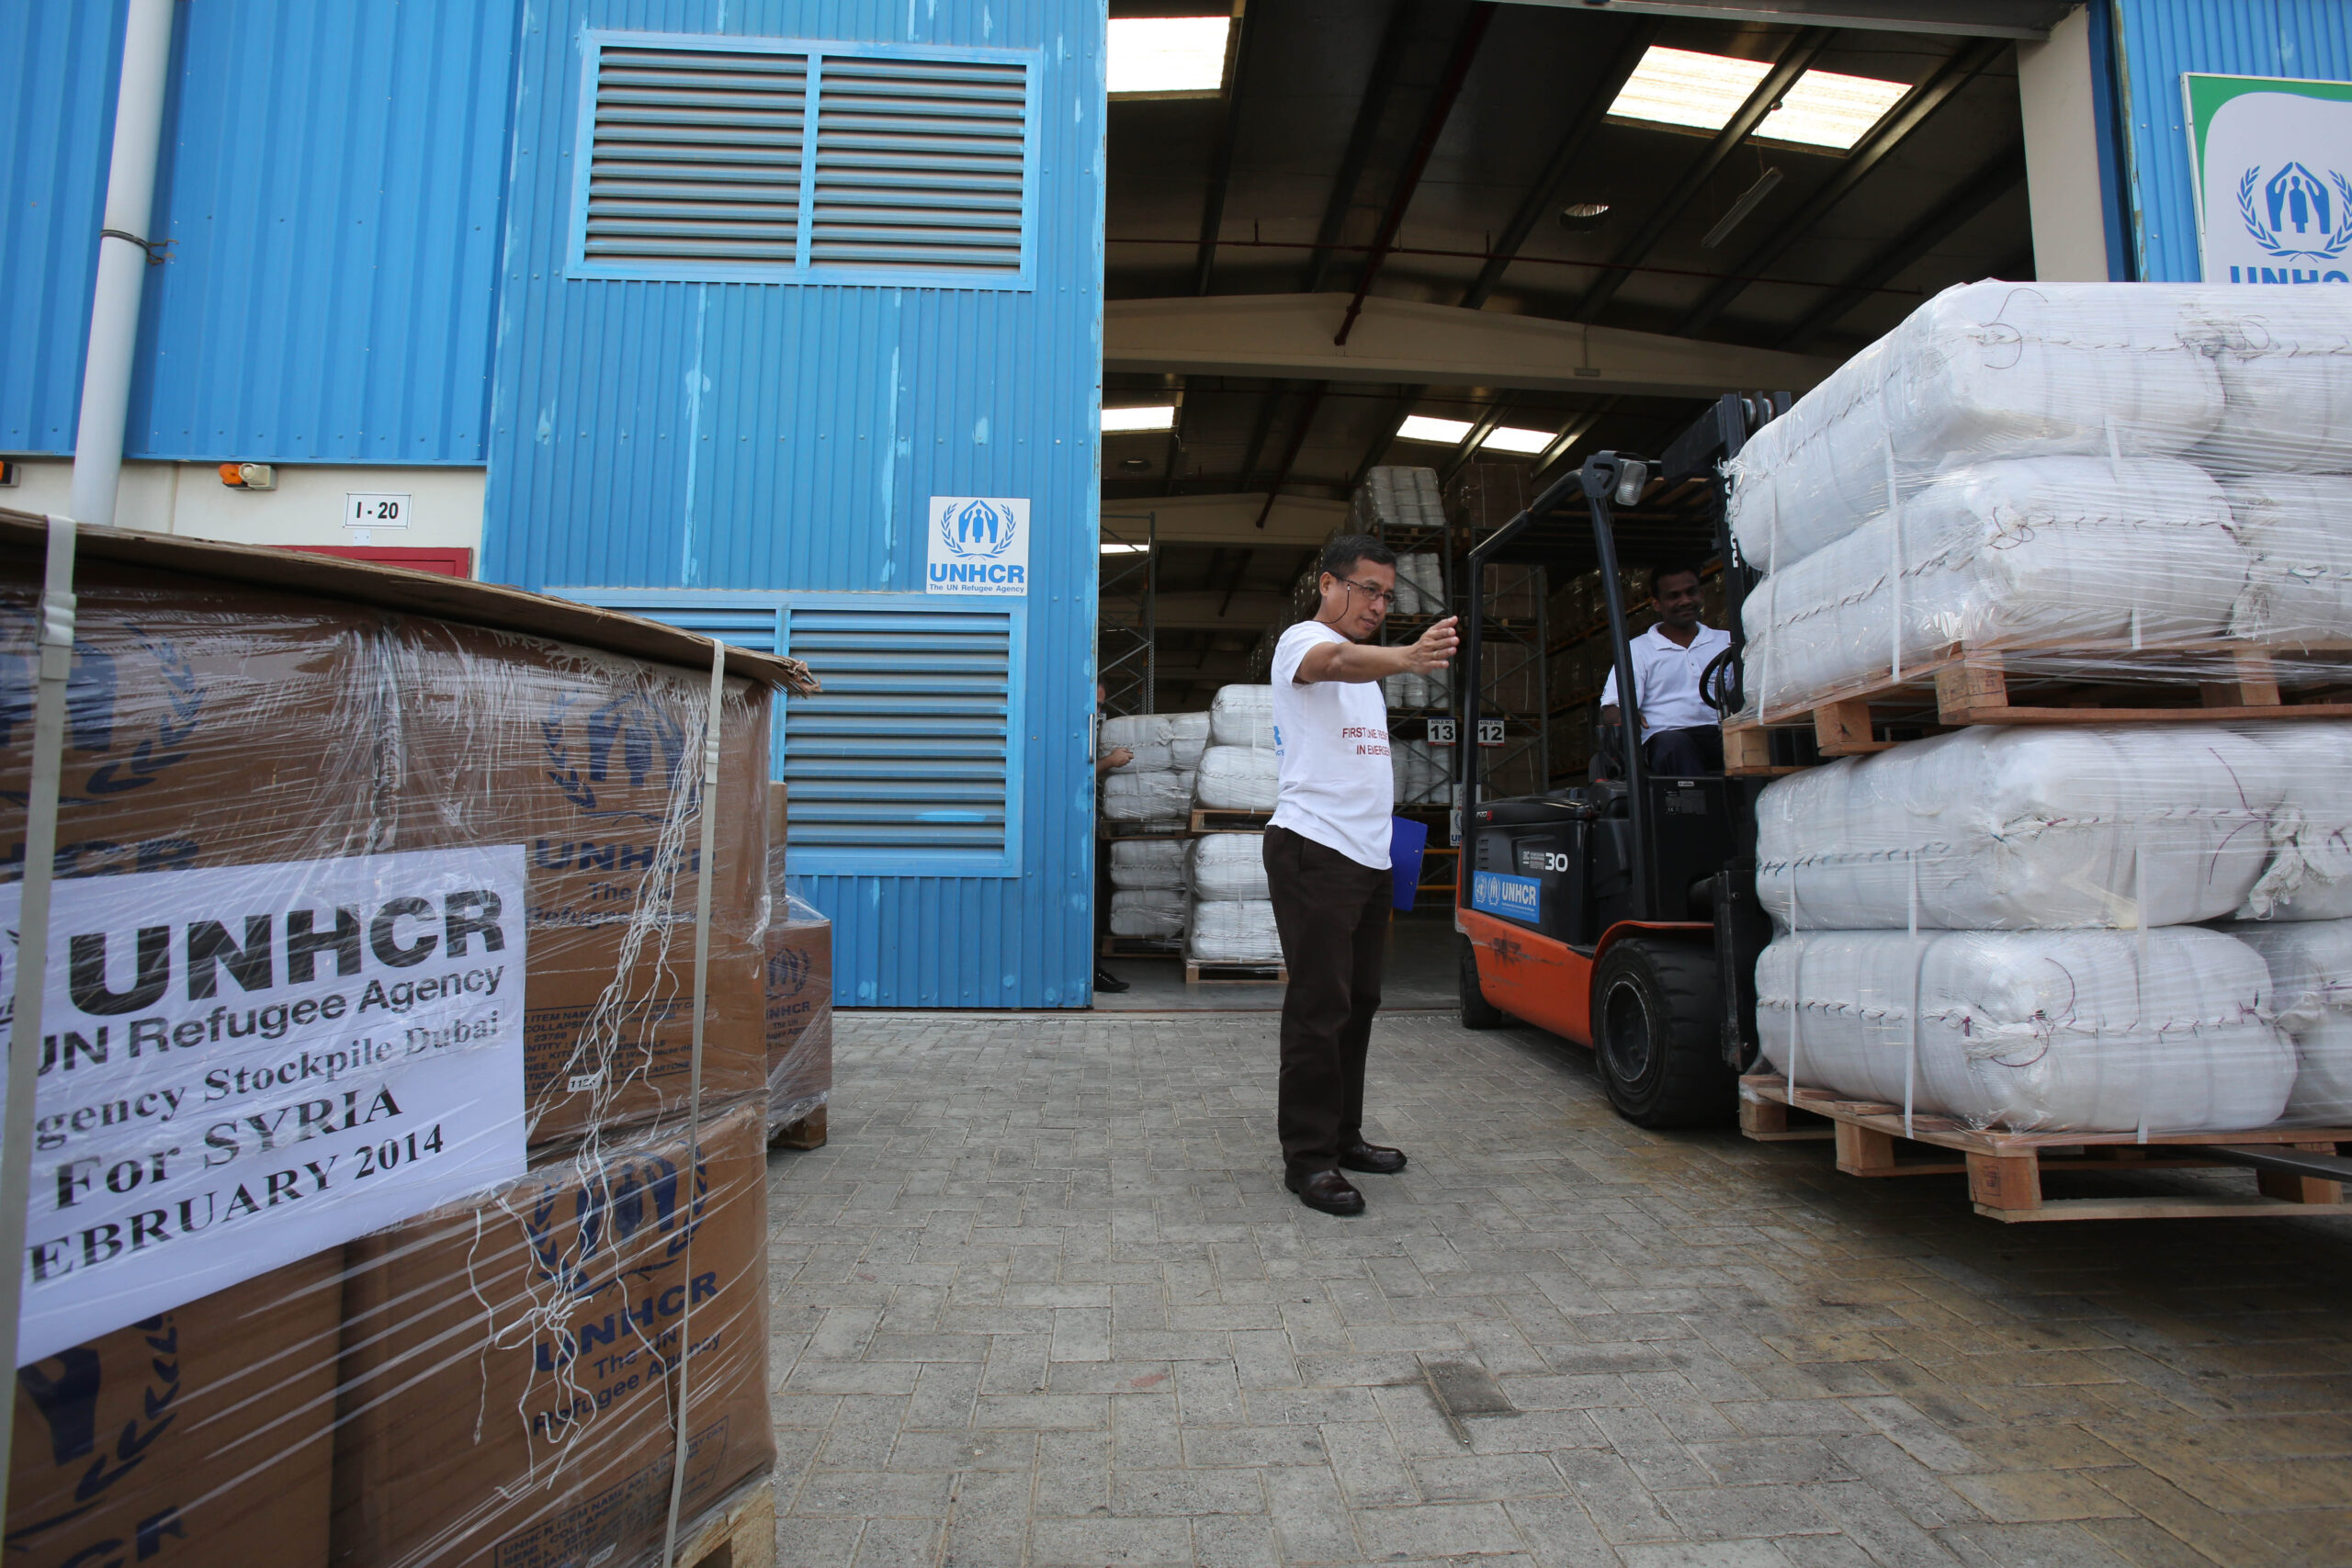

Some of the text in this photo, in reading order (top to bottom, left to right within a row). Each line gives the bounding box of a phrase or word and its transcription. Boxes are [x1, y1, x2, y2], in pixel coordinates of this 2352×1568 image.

[930, 563, 1024, 583] UNHCR
[961, 584, 993, 592] Refugee
[996, 585, 1024, 593] Agency
[1342, 728, 1366, 739] FIRST
[1430, 725, 1453, 740] 13
[1479, 726, 1502, 741] 12
[1357, 745, 1366, 755] IN
[1544, 852, 1568, 872] 30
[589, 882, 632, 901] The
[1501, 881, 1537, 907] UNHCR
[69, 888, 506, 1017] UNHCR
[129, 990, 347, 1058] Refugee
[358, 964, 505, 1015] Agency
[36, 1010, 499, 1152] gency Stockpile Dubai
[51, 1082, 404, 1212] For SYRIA
[27, 1123, 444, 1284] EBRUARY 2014
[536, 1271, 718, 1373] UNHCR
[593, 1325, 678, 1380] The UN
[532, 1332, 721, 1438] Refugee Agency
